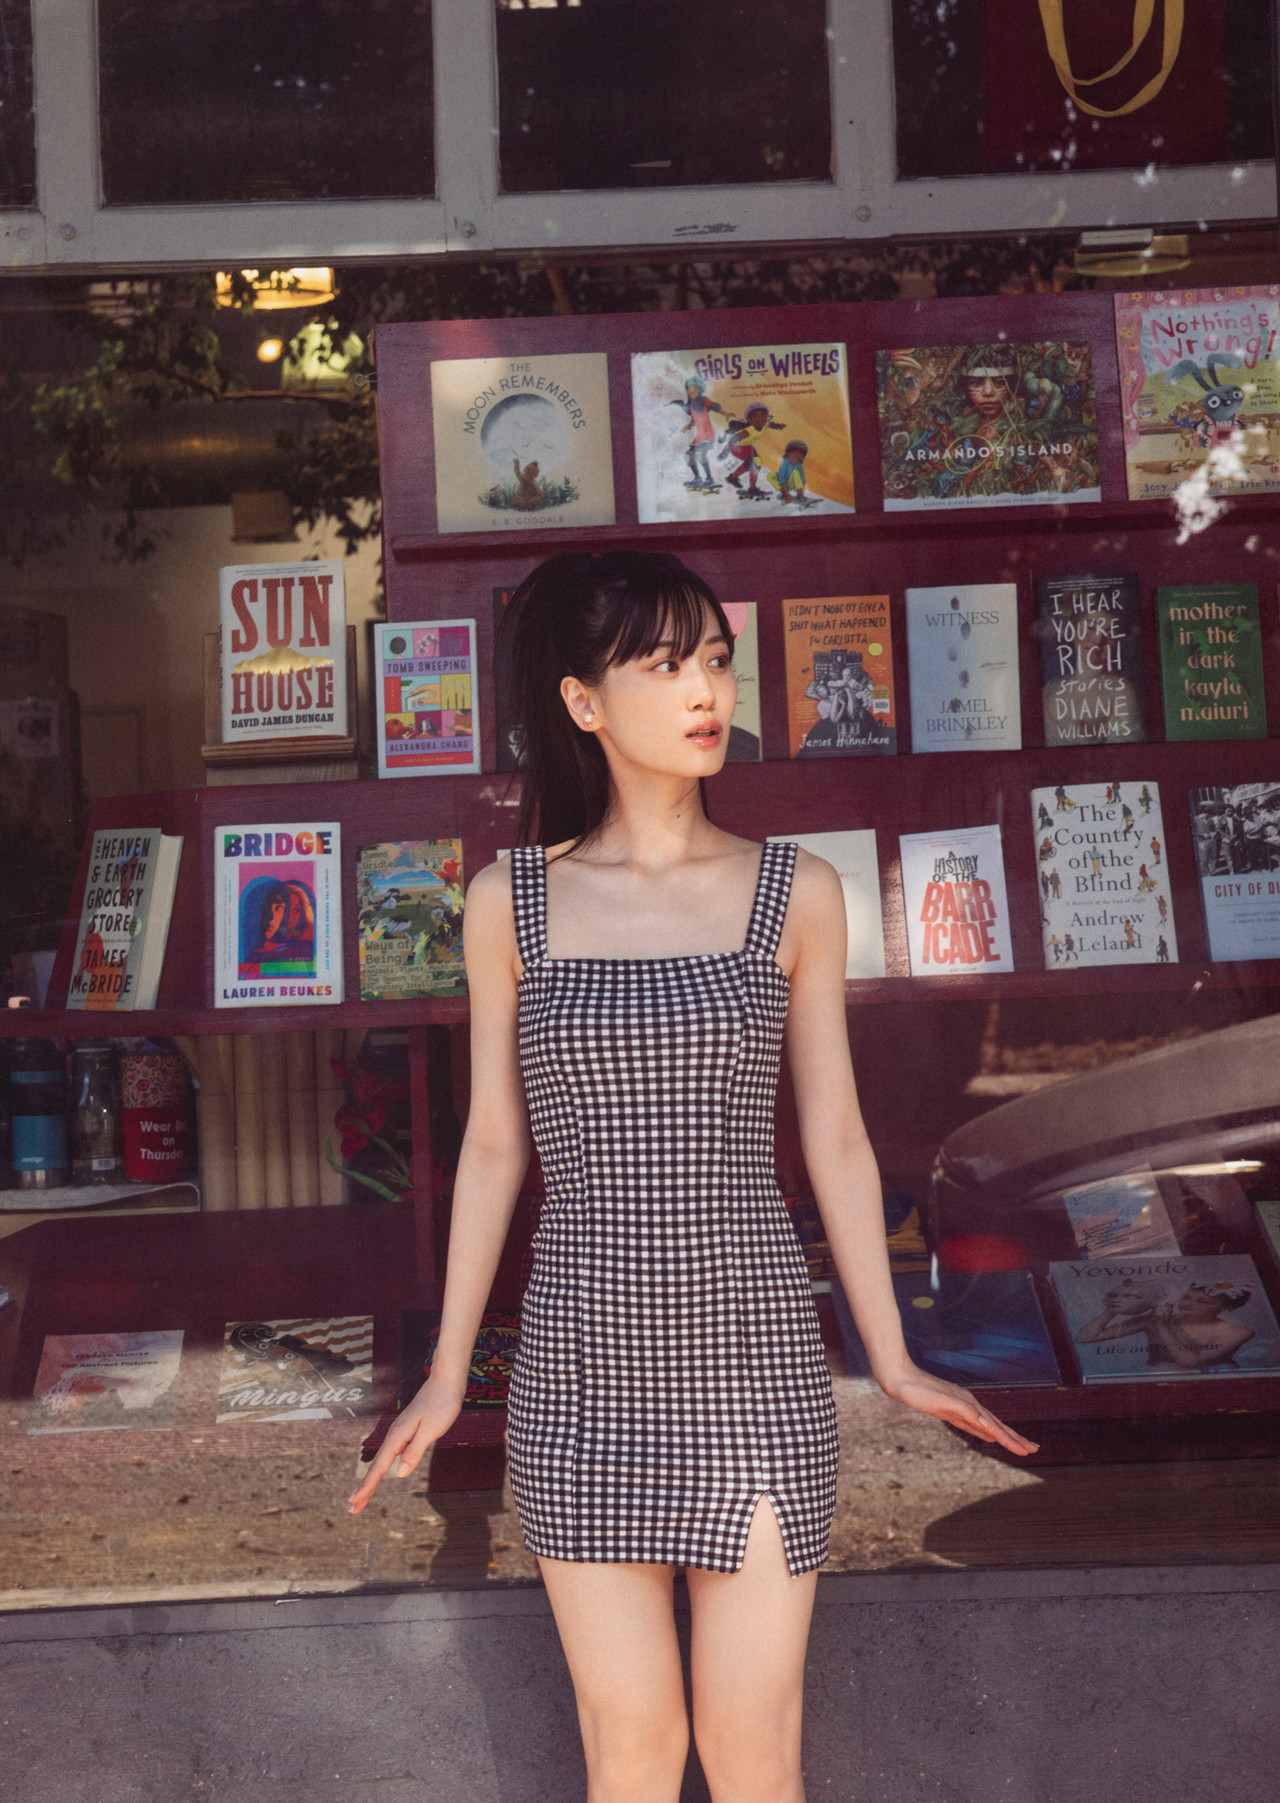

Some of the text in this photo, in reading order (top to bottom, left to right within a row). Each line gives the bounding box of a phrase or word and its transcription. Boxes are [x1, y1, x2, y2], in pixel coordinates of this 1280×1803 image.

[1150, 304, 1269, 344] Nothing's
[1153, 330, 1277, 369] Wrong!
[510, 363, 531, 372] THE
[748, 358, 765, 370] ON
[770, 349, 840, 378] WHEELS
[463, 375, 586, 435] MOON REMEMBERS
[905, 443, 1073, 461] ARMANDO'S ISLAND
[516, 515, 565, 525] GOODALE
[788, 602, 886, 617] DIDN'T NOBODY GIVE A
[1050, 589, 1123, 615] I HEAR
[231, 575, 333, 654] SUN
[925, 611, 1000, 628] WITNESS
[1169, 602, 1247, 621] mother
[788, 617, 886, 632] SHIT WHAT HAPPENED
[1052, 618, 1126, 643] YOU'RE
[823, 634, 868, 646] CARLOTTA
[1207, 626, 1240, 644] the
[387, 660, 466, 674] TOMB SWEEPING
[1056, 641, 1122, 676] RICH
[1187, 651, 1235, 669] dark
[231, 667, 333, 715] HOUSE
[939, 699, 992, 714] JAMEL
[1056, 695, 1129, 720] DIANE
[231, 713, 334, 729] DAVID JAMES DUNCAN
[926, 716, 1008, 733] BRINKLEY
[1056, 720, 1131, 739] WILLIAMS
[389, 740, 468, 752] ALEXANDRA CHANG
[799, 733, 832, 749] James
[1074, 803, 1116, 823] The
[224, 831, 332, 858] BRIDGE
[1054, 828, 1143, 849] Country
[101, 836, 151, 860] HEAVEN
[362, 860, 394, 870] Bridle
[934, 855, 978, 873] HISTORY
[1068, 849, 1134, 870] of the
[91, 862, 147, 883] & EARTH
[932, 872, 979, 883] OF THE
[1075, 872, 1132, 893] Blind
[1214, 883, 1241, 898] CITY
[1248, 882, 1262, 895] OF
[87, 887, 144, 909] GROCERY
[920, 879, 997, 923] BARR
[89, 914, 131, 935] STORE
[1071, 910, 1145, 928] Andrew
[366, 939, 410, 953] Ways of
[922, 919, 1001, 965] ICADE
[1078, 934, 1142, 952] Leland
[82, 949, 126, 970] JAMES
[366, 953, 402, 966] Being
[70, 974, 133, 995] McBRIDE
[223, 986, 332, 999] LAUREN BEUKES
[140, 1121, 171, 1133] Wear
[162, 1137, 175, 1146] on
[1070, 1261, 1188, 1278] Yevonde
[1096, 1344, 1121, 1355] Life
[230, 1387, 364, 1408] Mingus
